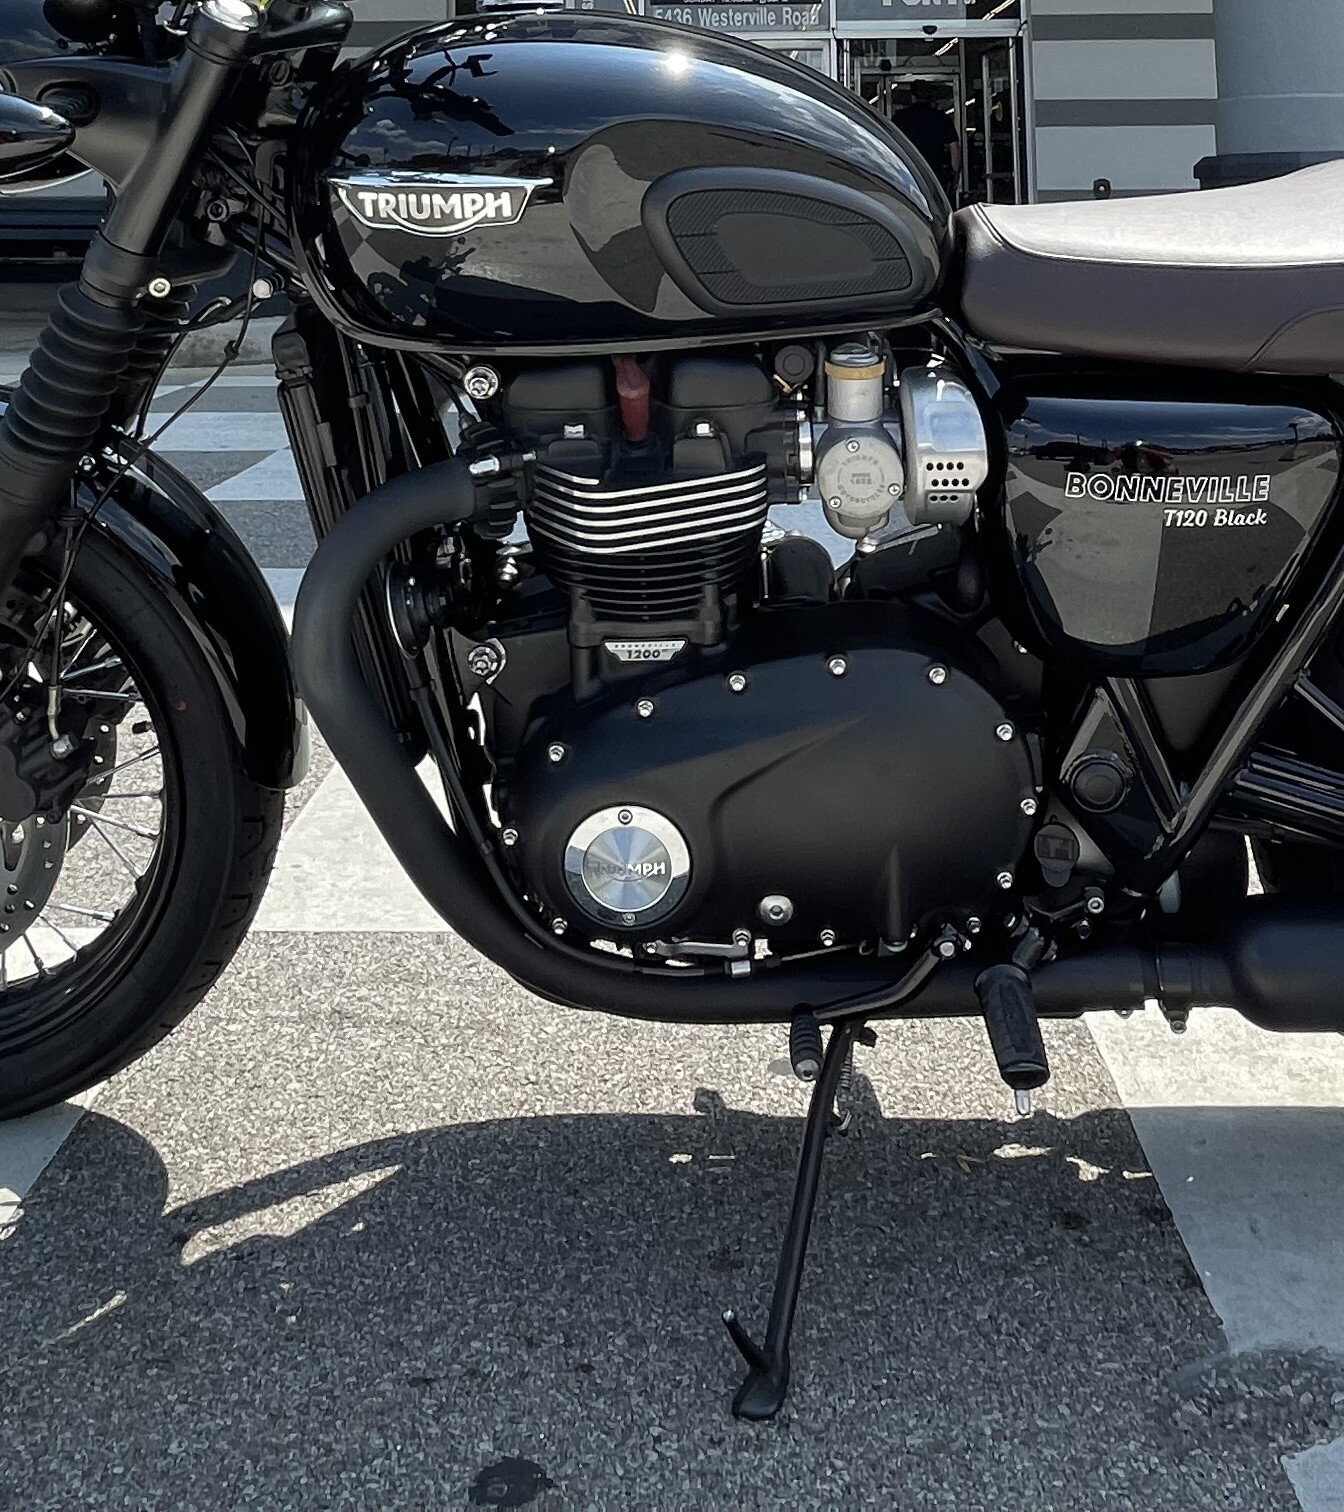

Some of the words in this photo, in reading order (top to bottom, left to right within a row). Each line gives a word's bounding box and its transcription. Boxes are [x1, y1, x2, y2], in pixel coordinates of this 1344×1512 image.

[698, 6, 776, 27] Westerville
[782, 6, 819, 25] Road
[357, 191, 513, 227] TRIUMPH
[1064, 472, 1271, 503] BONNEVILLE
[1163, 509, 1207, 527] T120
[1213, 508, 1267, 527] Black
[627, 649, 661, 659] 1200
